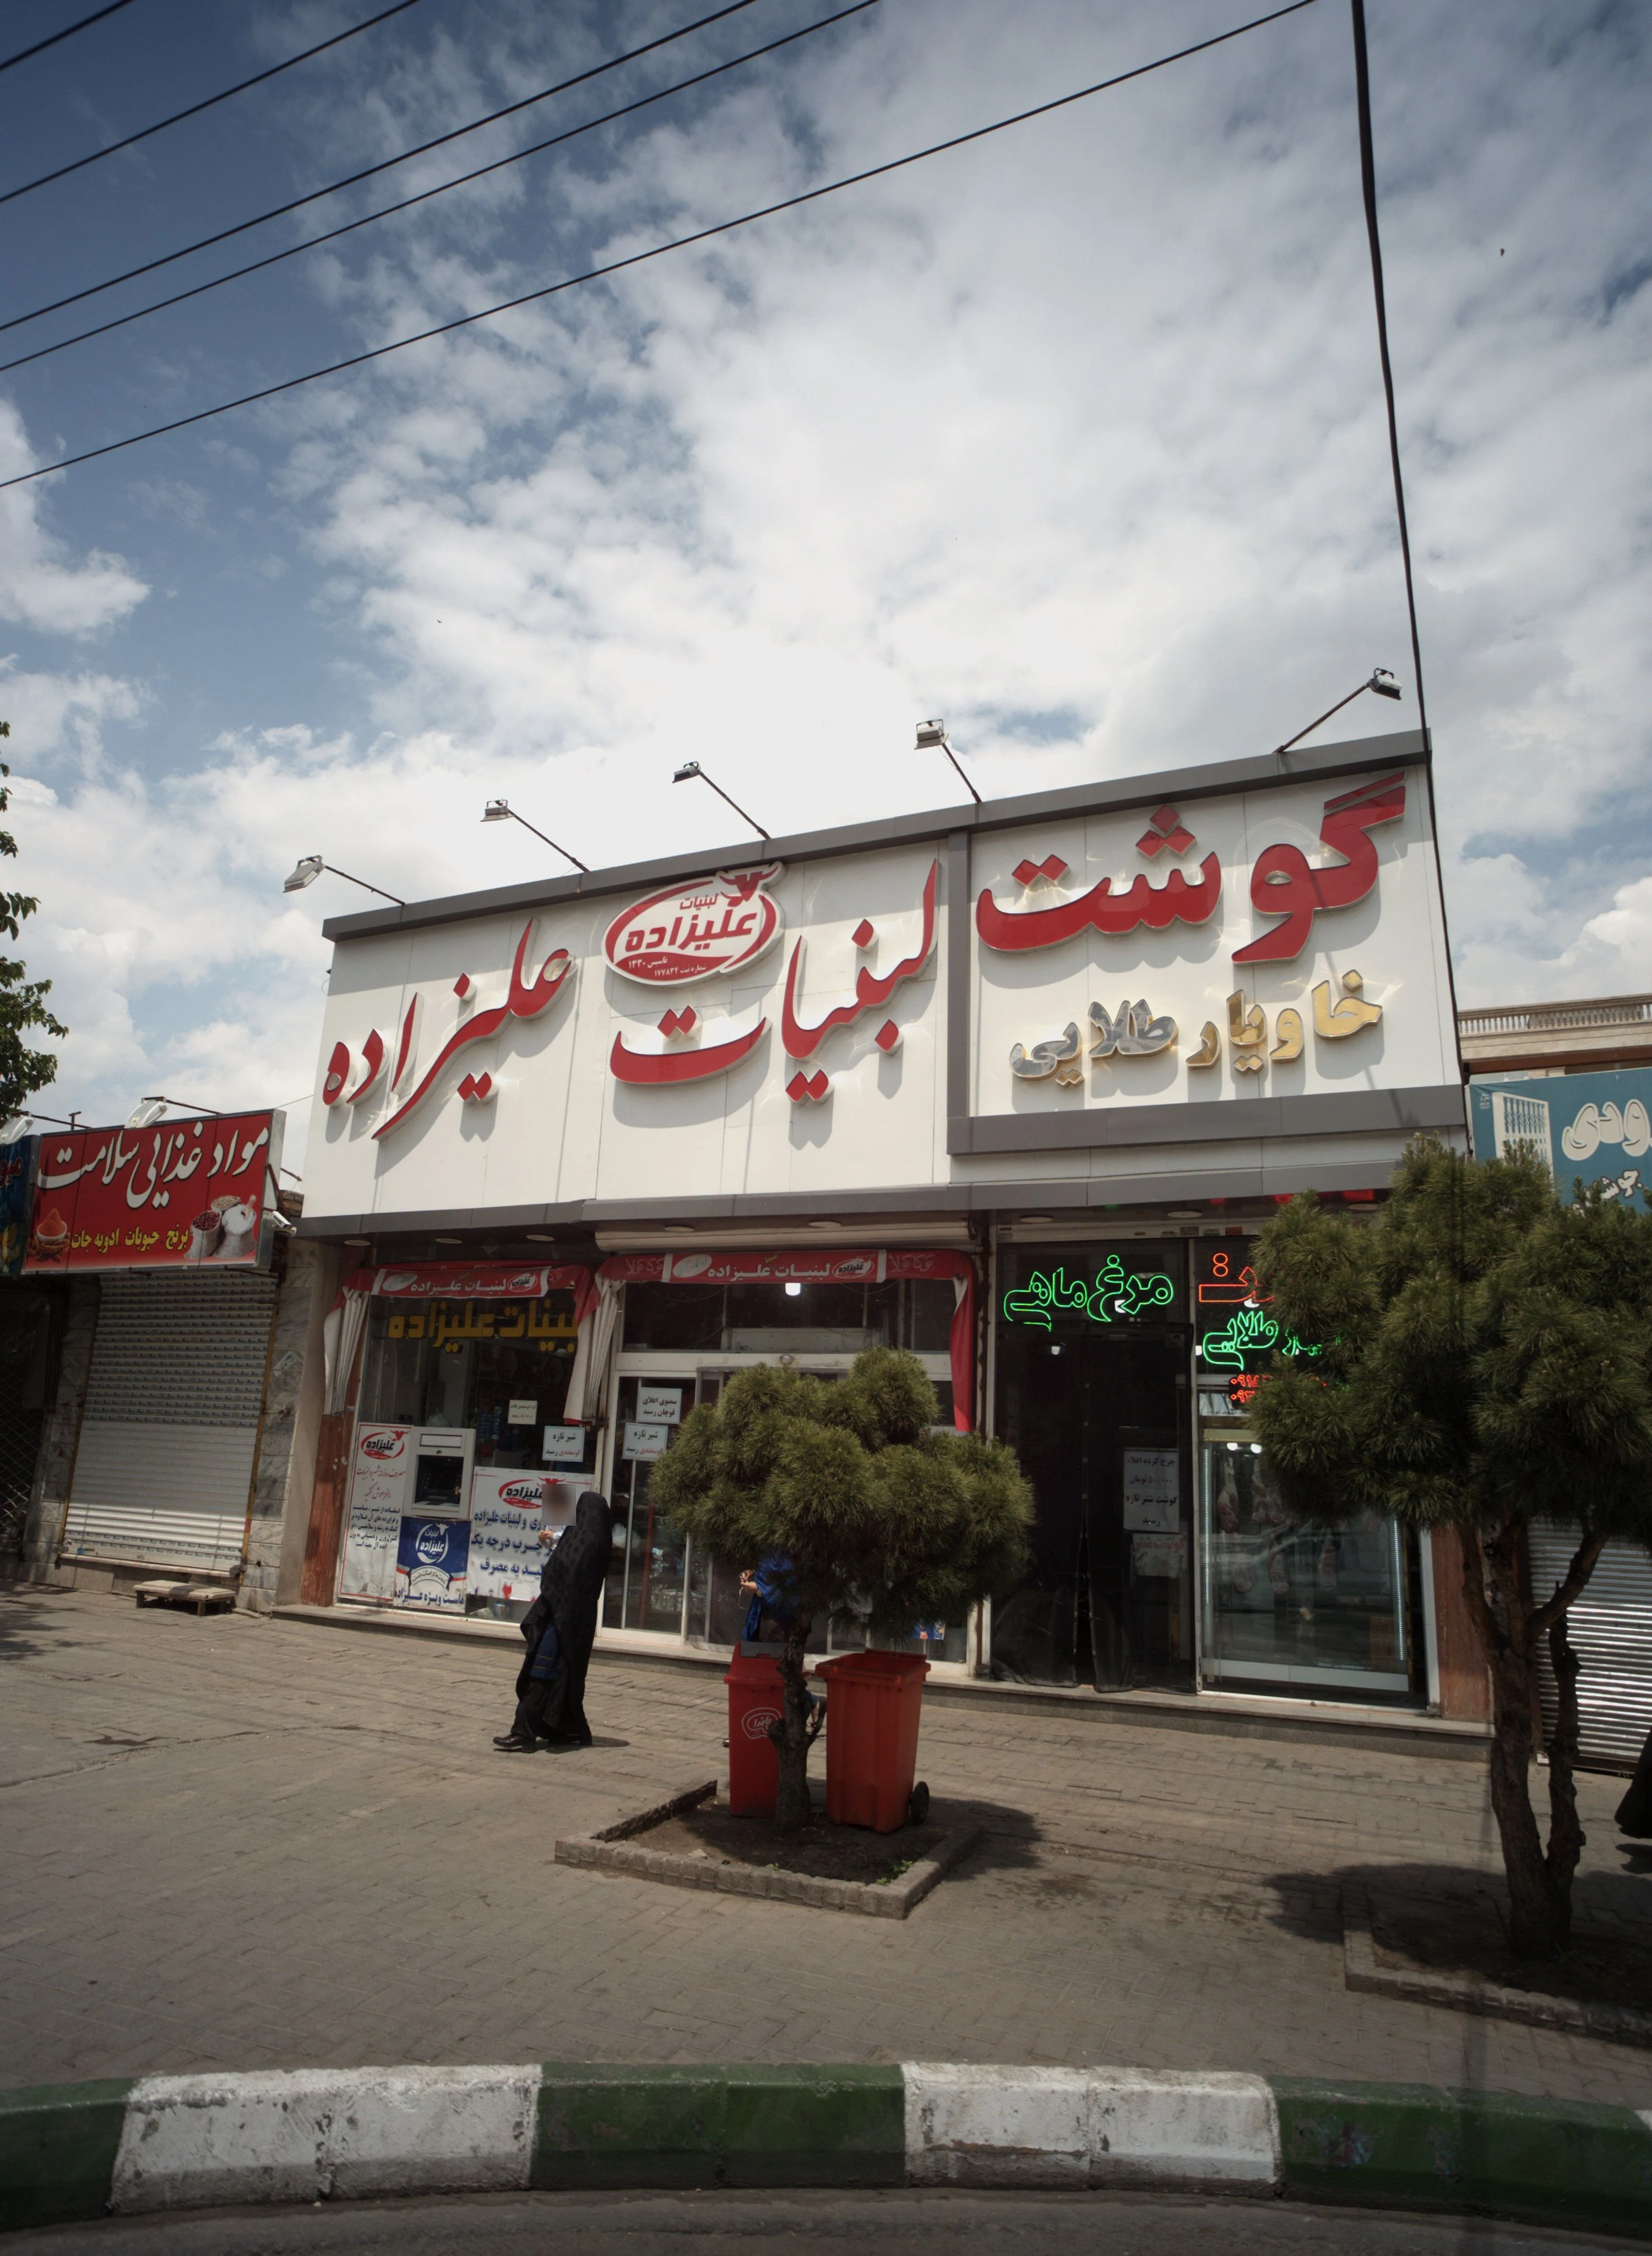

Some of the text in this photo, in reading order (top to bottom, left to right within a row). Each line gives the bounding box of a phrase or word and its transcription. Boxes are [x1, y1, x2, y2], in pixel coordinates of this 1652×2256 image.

[976, 772, 1405, 965] گوشت
[680, 893, 719, 911] لبنیات
[624, 909, 758, 953] علیزاده
[610, 858, 937, 1102] لبنیات
[323, 916, 574, 1140] علیزاده
[1009, 969, 1383, 1087] خاویار طلایی
[37, 1121, 269, 1209] مواد غذایی سلامت
[71, 1223, 189, 1253] برنج حبوبات ادویه جات
[707, 1262, 830, 1282] لبنیات علیزاده
[410, 1278, 462, 1295] علیزاده
[464, 1278, 507, 1295] لبنیات
[1087, 1255, 1173, 1322] مرغ
[1004, 1267, 1088, 1332] ماهی
[387, 1297, 578, 1354] بنیات علیزاده
[552, 1432, 577, 1442] شیر تازه
[633, 1430, 658, 1441] شیر تازه
[366, 1439, 395, 1454] علیزاده
[474, 1509, 498, 1527] علیزاده
[499, 1510, 522, 1529] لبنیات
[420, 1539, 445, 1555] علیزاده
[471, 1532, 483, 1549] یک
[486, 1536, 511, 1552] درجه
[480, 1557, 508, 1575] مصرف
[393, 1587, 465, 1607] ماست ویژه علیزاده
